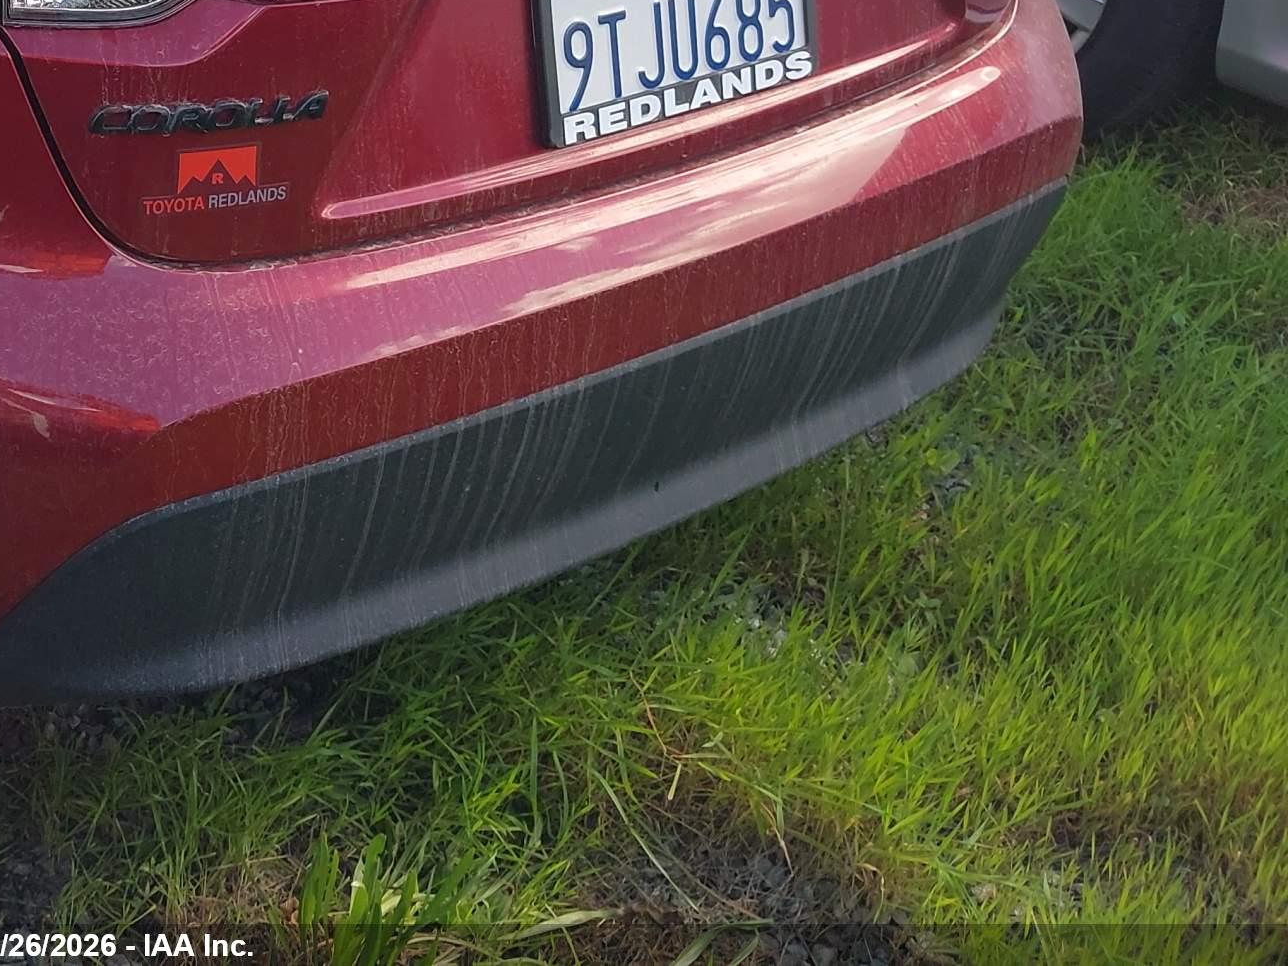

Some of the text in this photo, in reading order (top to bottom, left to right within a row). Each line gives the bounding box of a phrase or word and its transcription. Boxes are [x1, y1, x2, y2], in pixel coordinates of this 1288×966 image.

[90, 90, 329, 134] COROLLA
[564, 51, 812, 145] REDLANDS
[212, 173, 224, 184] R
[143, 185, 287, 216] TOYOTA REDLANDS
